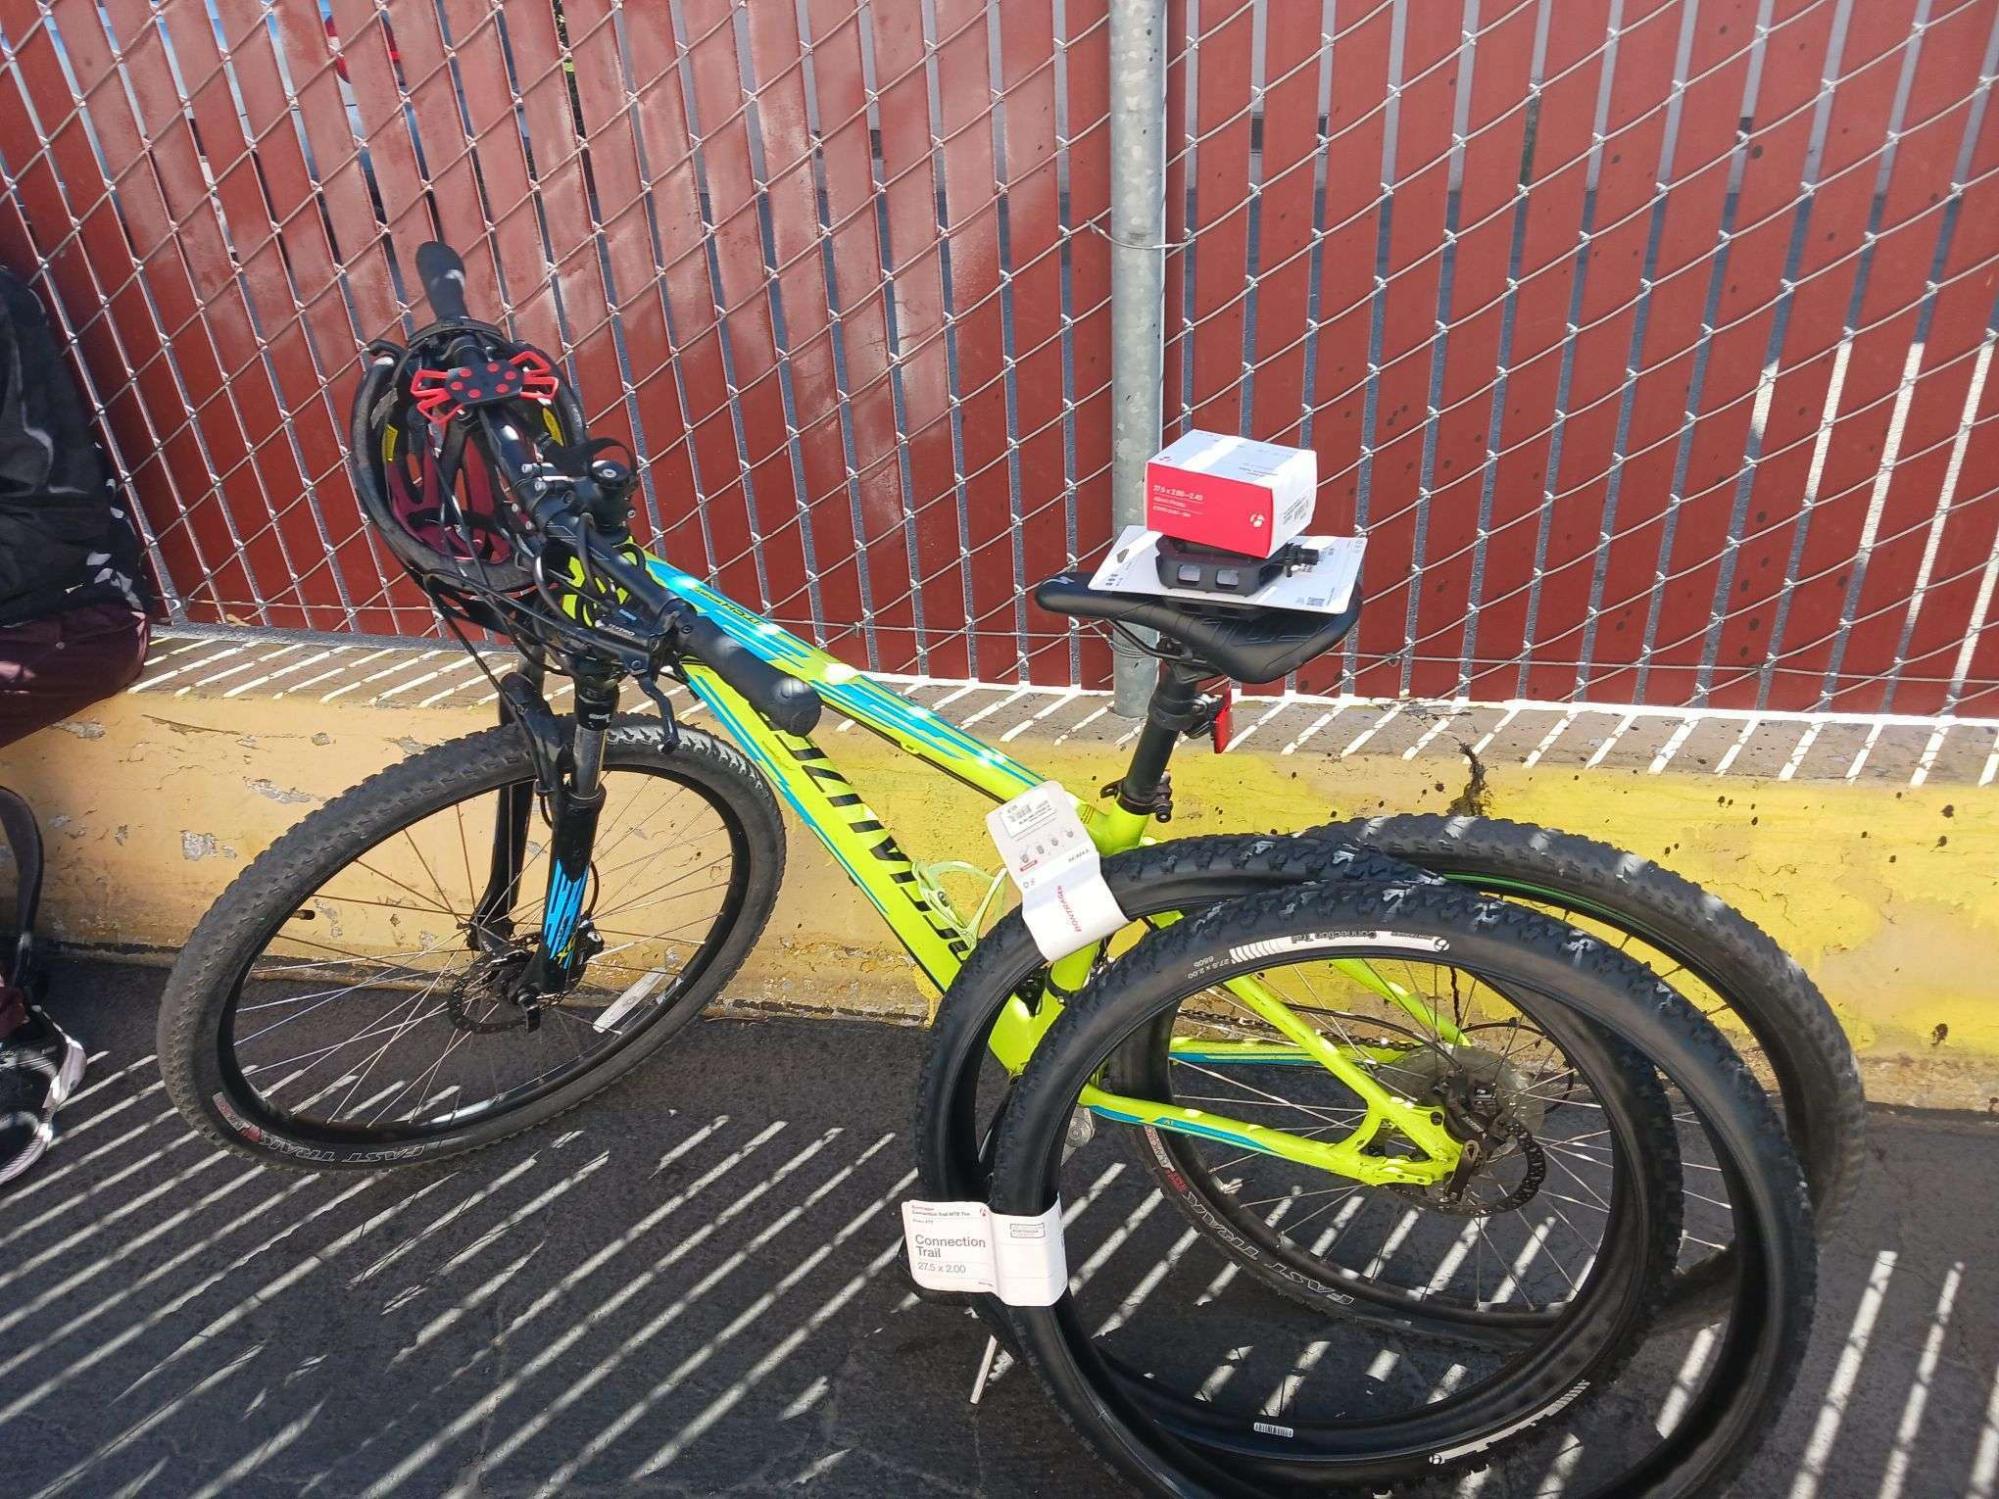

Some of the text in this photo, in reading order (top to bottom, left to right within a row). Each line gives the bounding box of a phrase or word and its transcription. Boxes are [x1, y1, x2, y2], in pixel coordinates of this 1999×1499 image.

[342, 1145, 425, 1163] FAST
[915, 1234, 986, 1248] Connection
[916, 1246, 942, 1258] Trail
[917, 1262, 936, 1272] 27.5
[945, 1264, 966, 1273] 2.00
[1264, 1262, 1355, 1305] FAST
